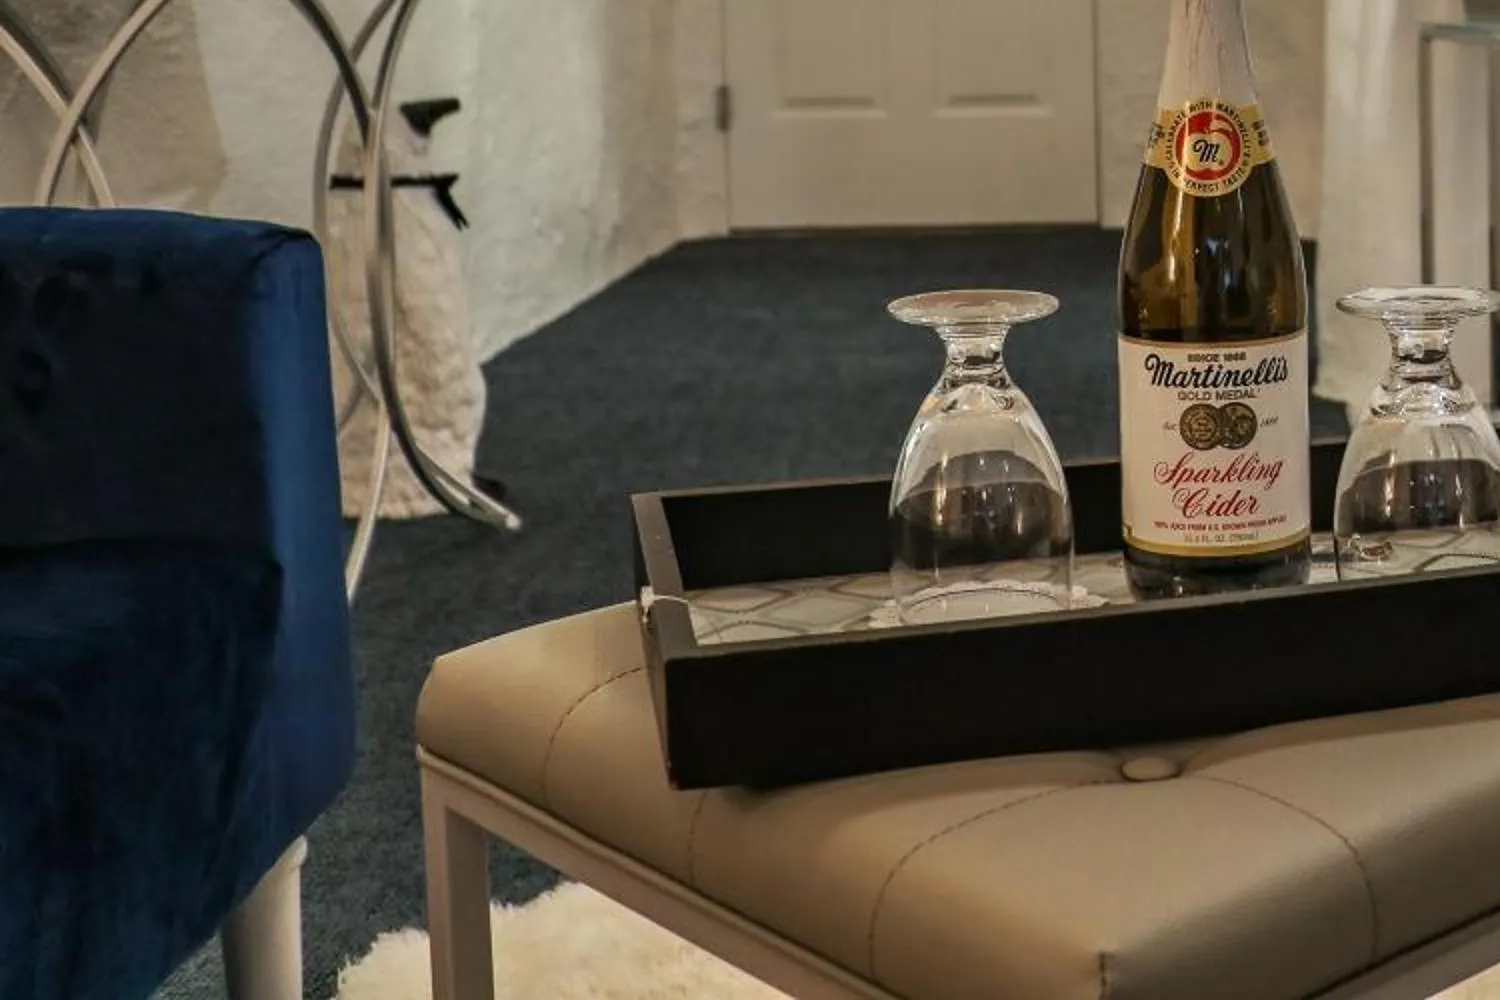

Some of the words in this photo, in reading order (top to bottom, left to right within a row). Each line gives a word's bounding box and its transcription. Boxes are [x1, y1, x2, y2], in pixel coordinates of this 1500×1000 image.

[1177, 390, 1212, 401] GOLD
[1215, 387, 1257, 400] MEDAL
[1153, 451, 1283, 491] Sparkling
[1171, 487, 1259, 519] Cider
